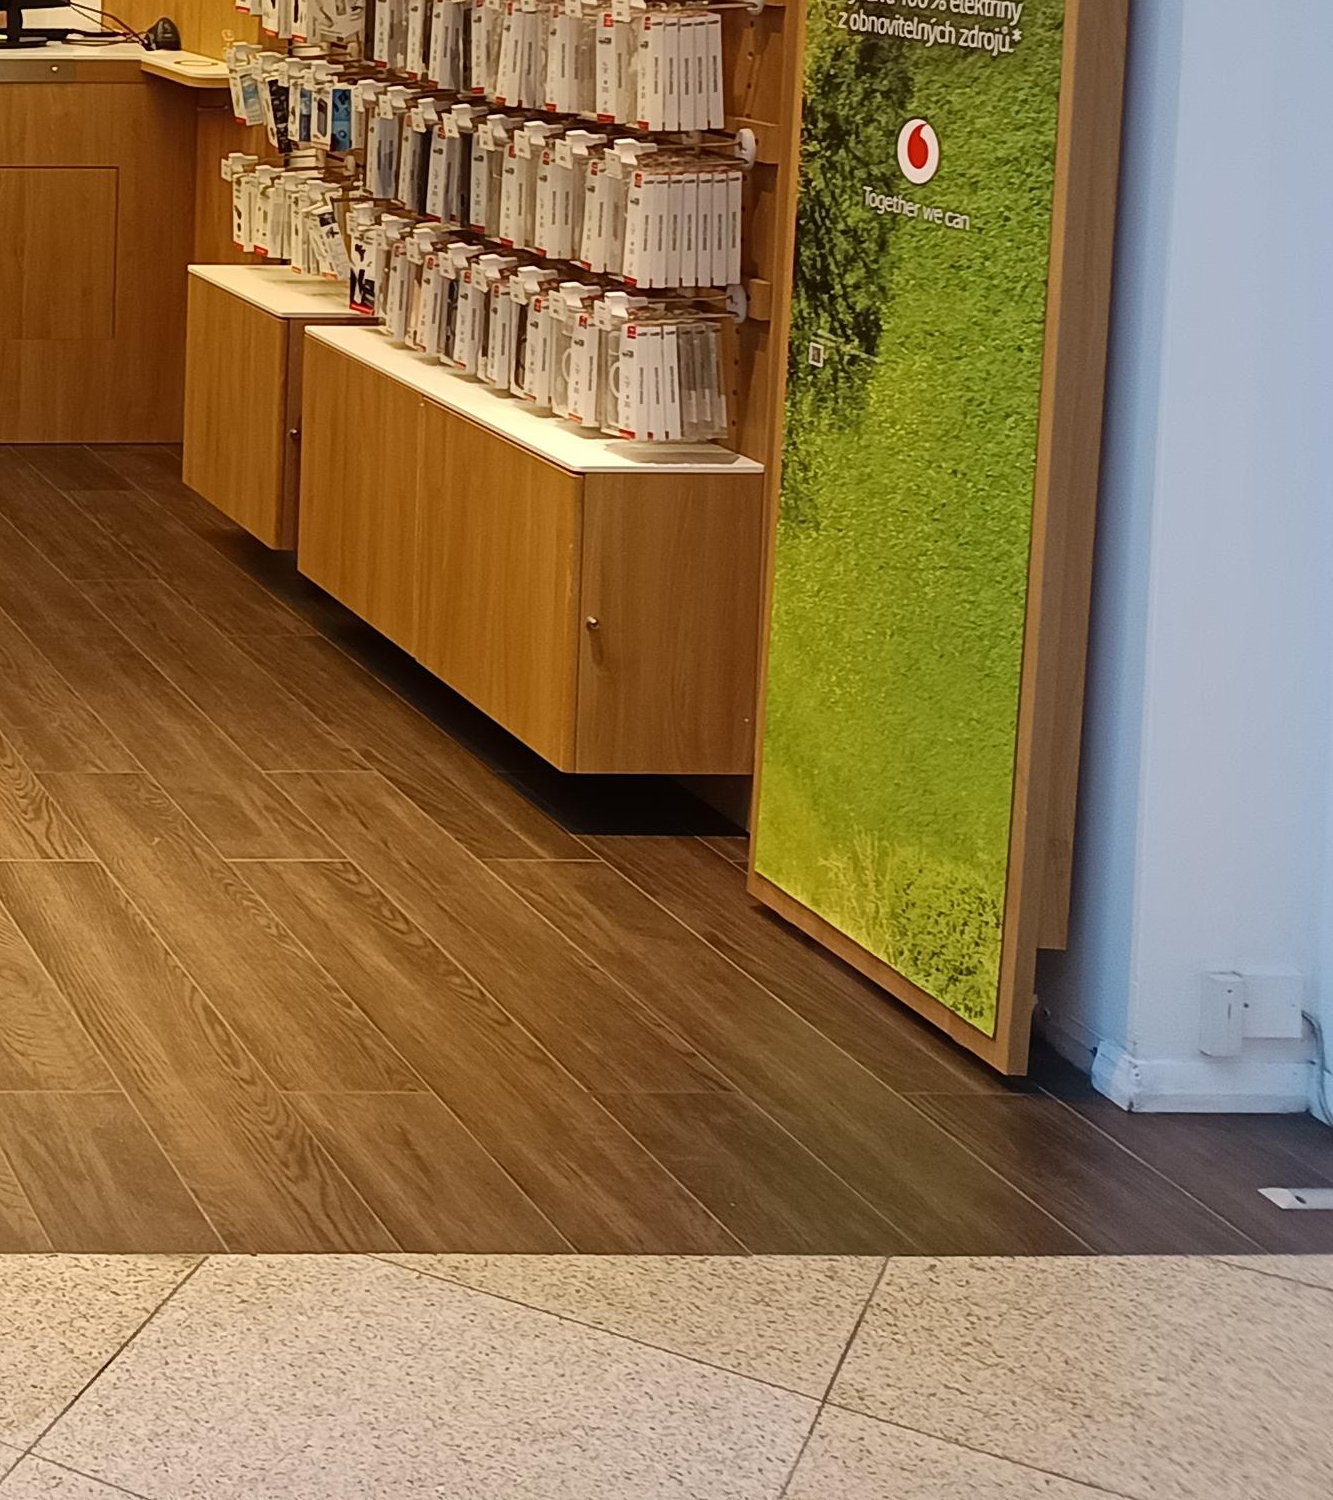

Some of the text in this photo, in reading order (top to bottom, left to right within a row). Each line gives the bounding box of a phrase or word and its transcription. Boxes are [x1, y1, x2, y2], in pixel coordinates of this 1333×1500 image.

[838, 11, 848, 29] z
[849, 9, 956, 47] obnovitelných
[862, 185, 970, 231] Together we can
